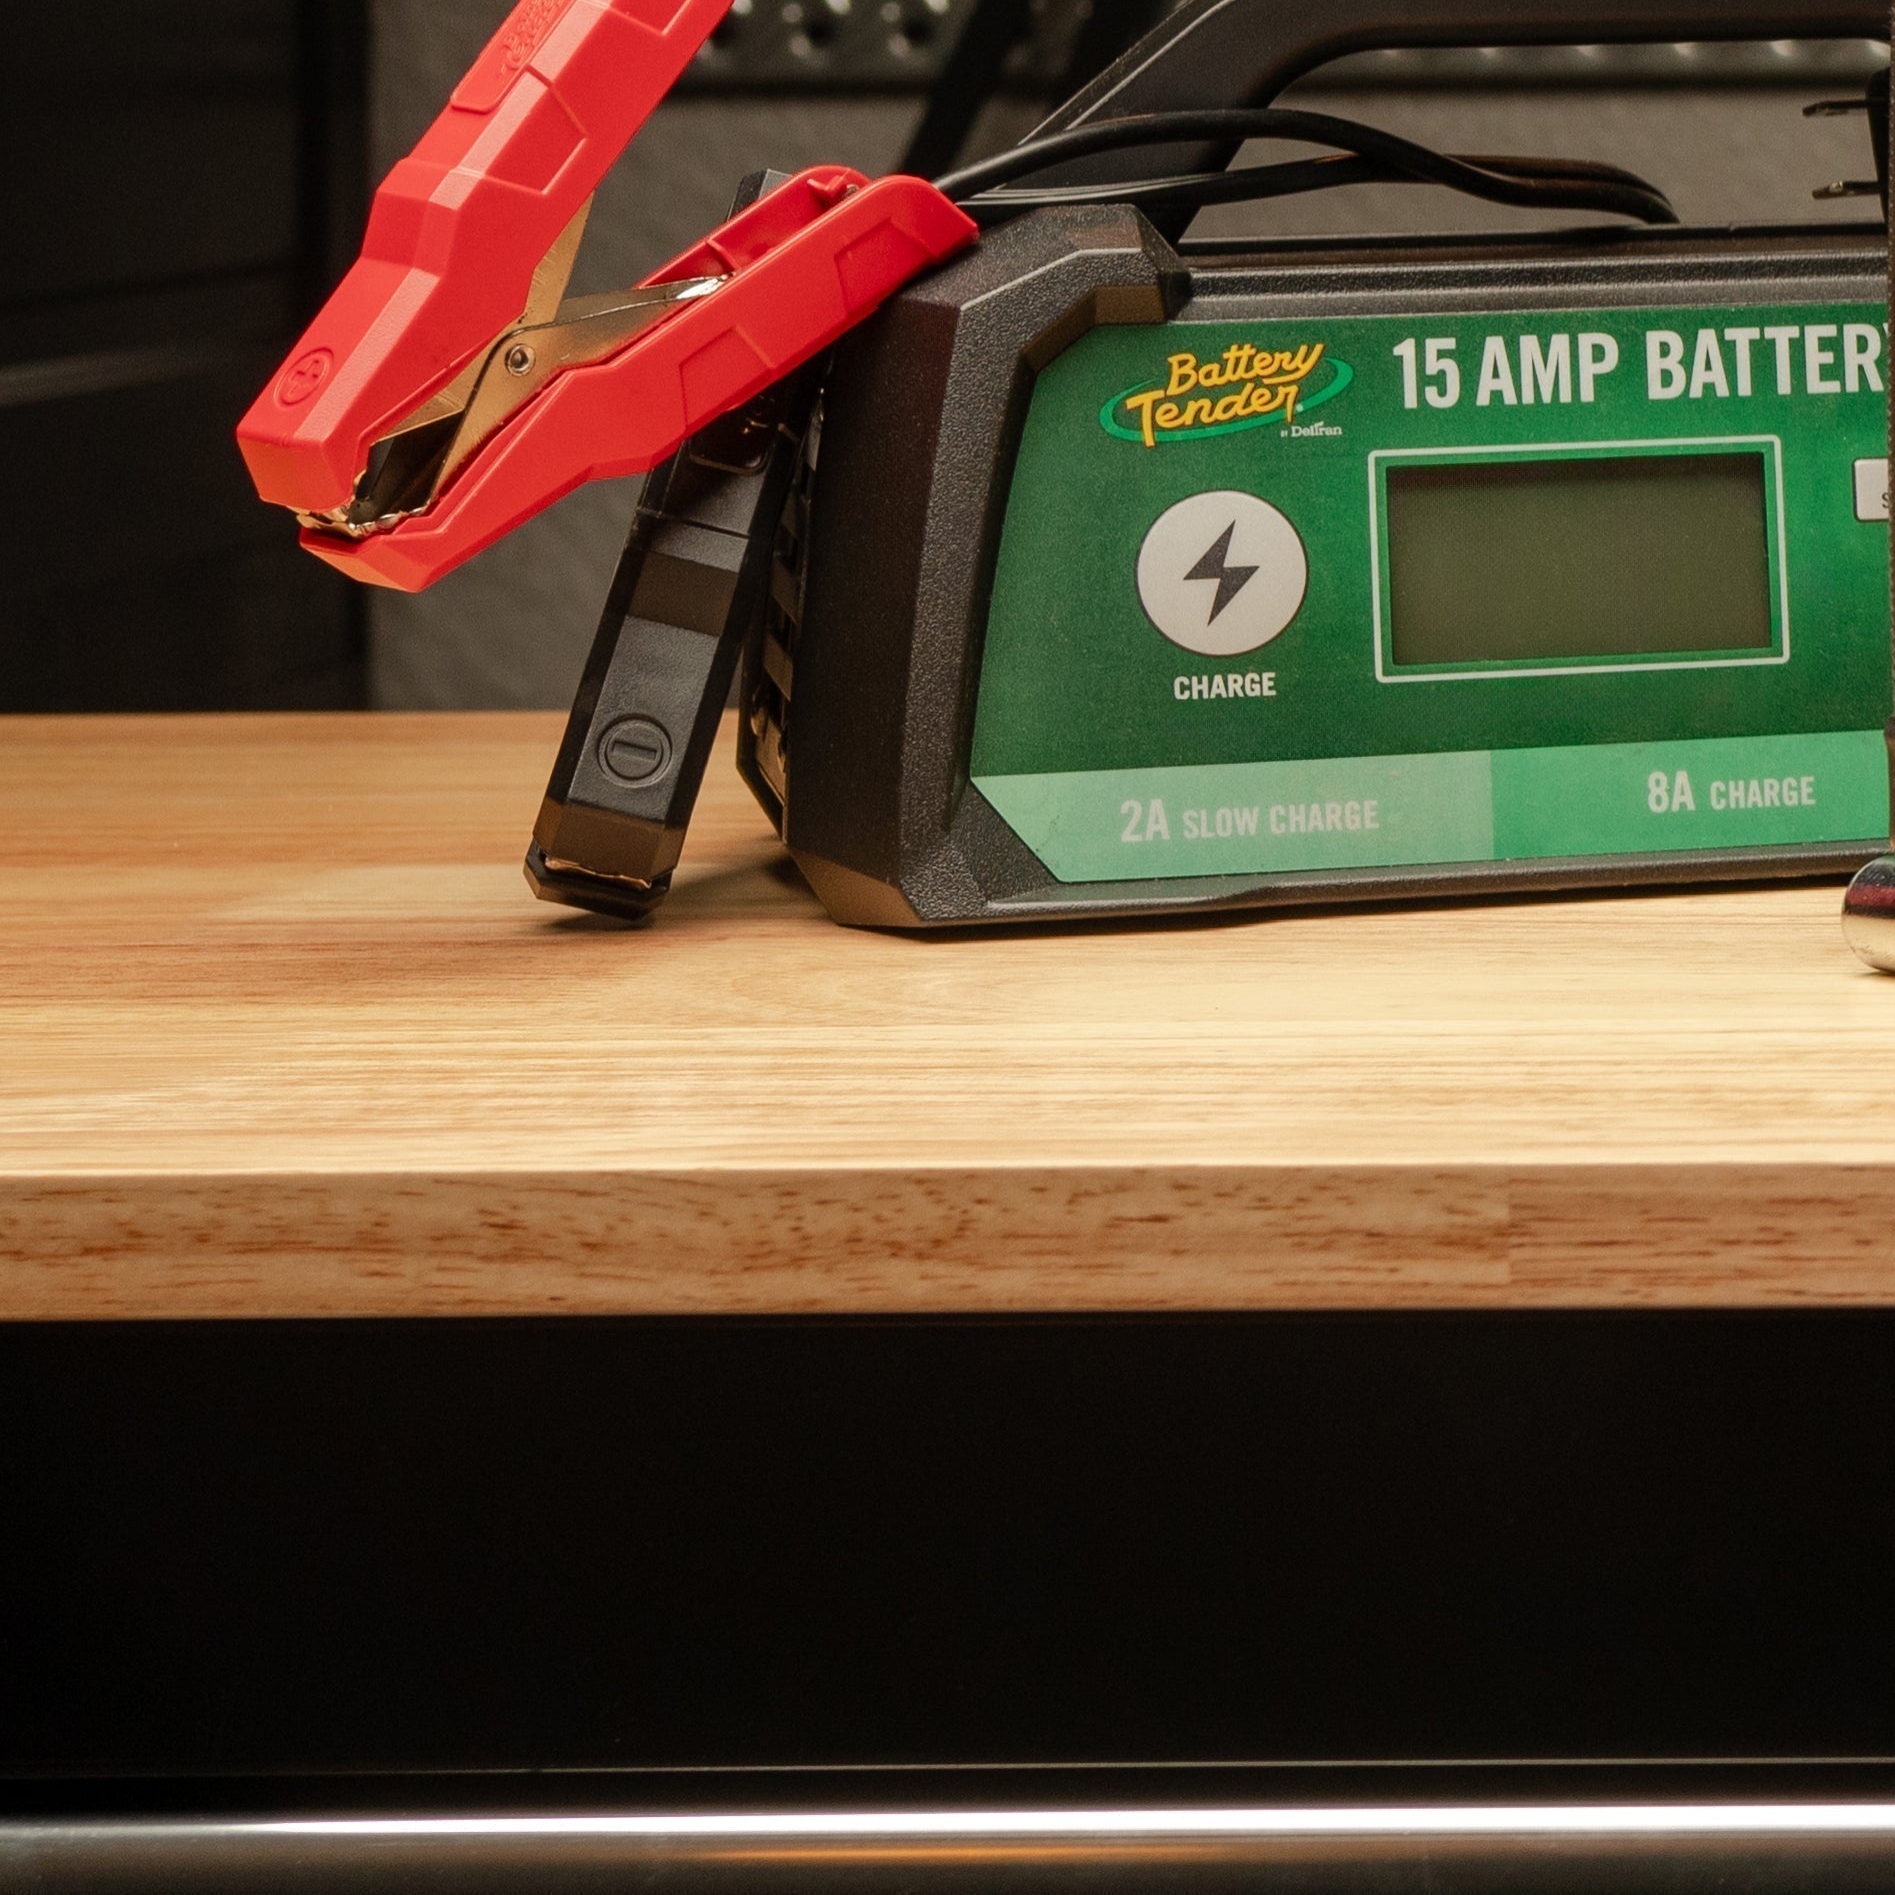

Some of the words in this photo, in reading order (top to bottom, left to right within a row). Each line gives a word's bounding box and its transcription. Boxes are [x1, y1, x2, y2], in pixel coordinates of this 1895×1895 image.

[1167, 343, 1324, 395] Battery
[1393, 337, 1461, 408] 15
[1475, 332, 1618, 407] AMP
[1645, 322, 1889, 400] BATTER
[1126, 382, 1297, 448] Tender
[1173, 672, 1276, 700] CHARGE
[1647, 770, 1695, 813] 8A
[1709, 776, 1815, 810] CHARGE
[1120, 798, 1170, 843] 2A
[1182, 806, 1258, 838] SLOW
[1269, 799, 1380, 832] CHARGE
